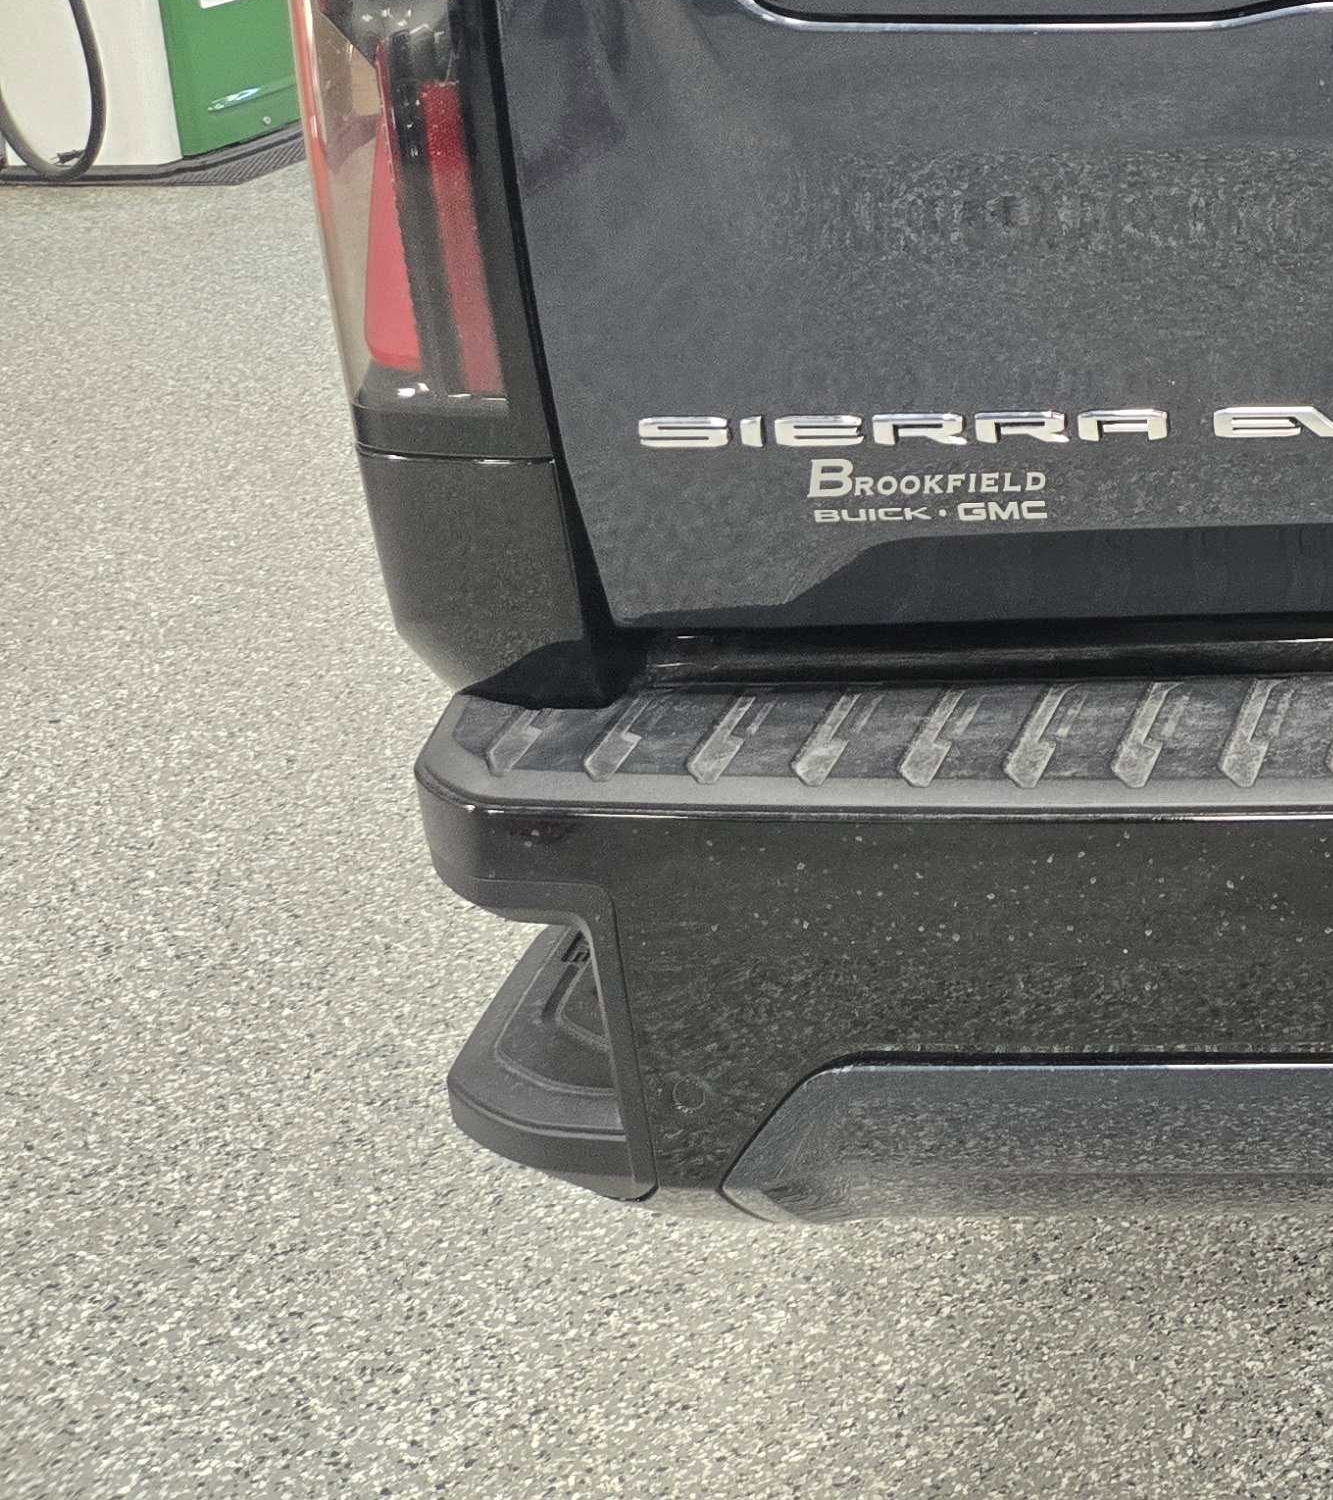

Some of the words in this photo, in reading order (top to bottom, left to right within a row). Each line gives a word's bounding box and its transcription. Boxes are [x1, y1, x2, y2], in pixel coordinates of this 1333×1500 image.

[637, 407, 1170, 449] SIERRA
[807, 458, 1047, 498] BROOKFIELD
[813, 507, 932, 522] BUICK
[957, 500, 1048, 521] GMC
